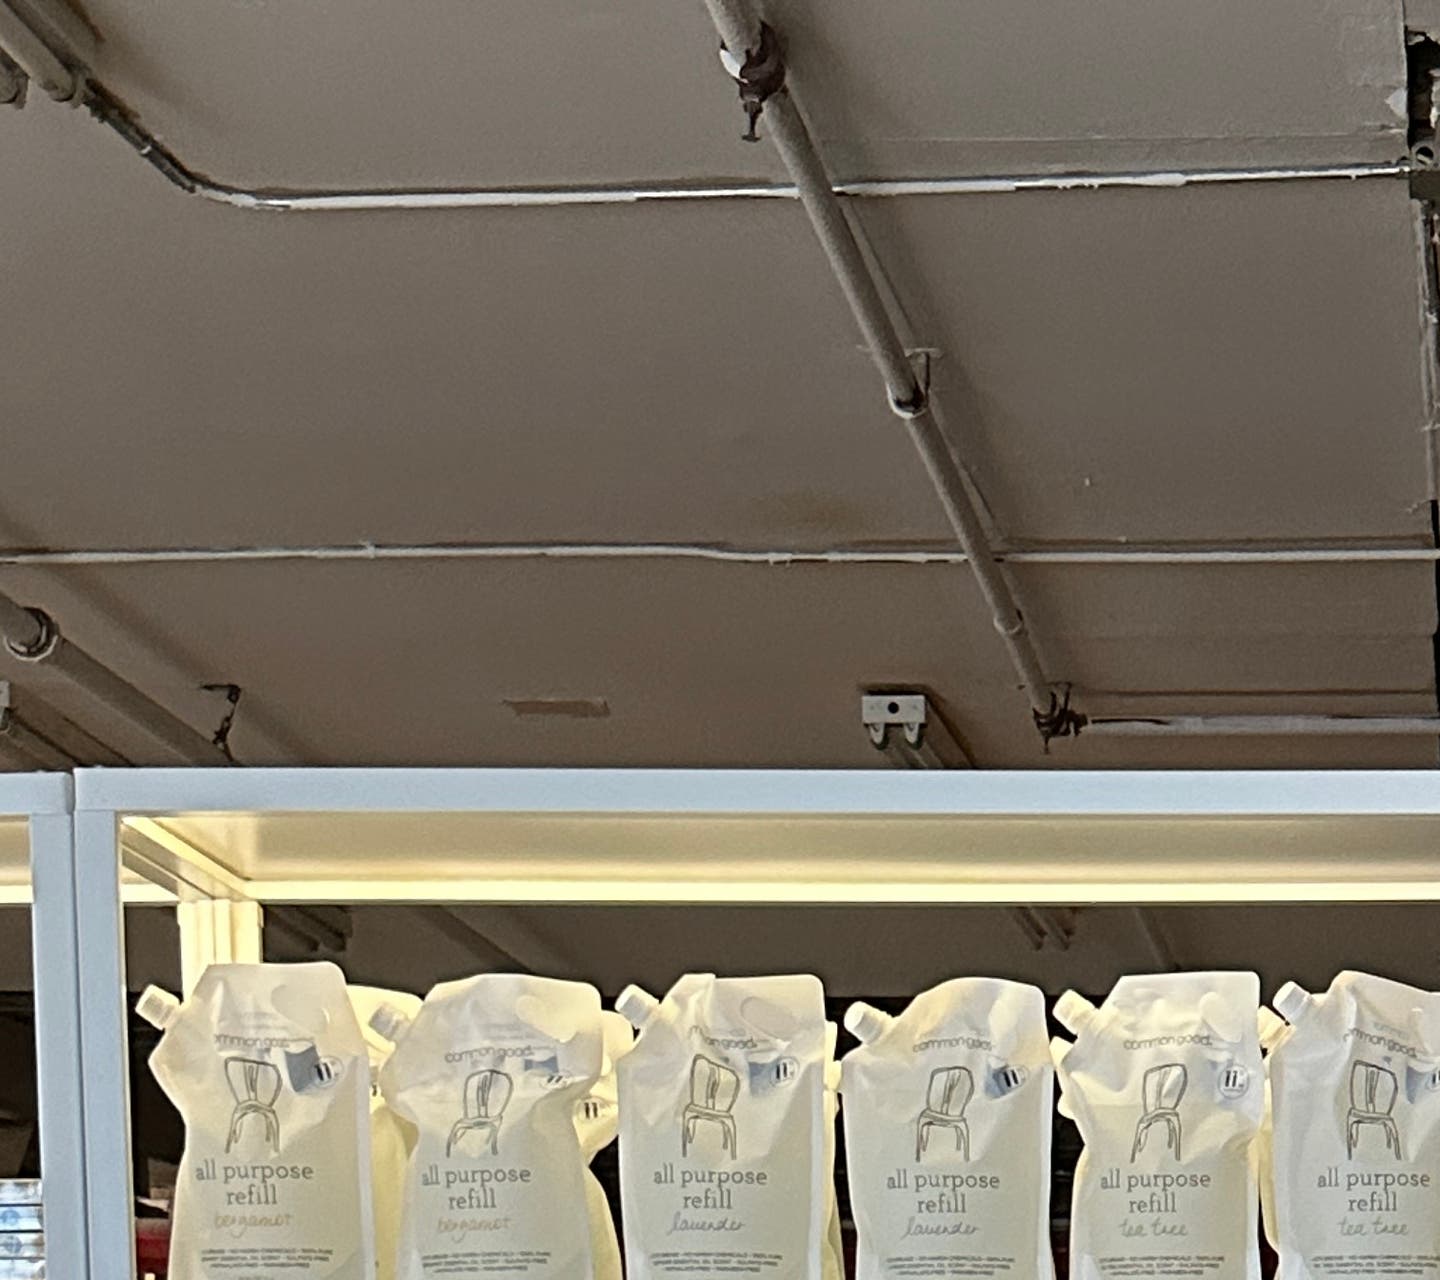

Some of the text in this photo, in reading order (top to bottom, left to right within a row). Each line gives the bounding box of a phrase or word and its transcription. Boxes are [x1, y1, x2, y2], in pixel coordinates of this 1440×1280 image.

[195, 1159, 314, 1184] all purpose
[421, 1165, 532, 1188] all purpose
[653, 1163, 768, 1188] all purpose
[886, 1169, 1001, 1192] all purpose
[1100, 1168, 1211, 1193] all purpose
[1317, 1167, 1431, 1192] all purpose
[226, 1184, 278, 1206] refill
[448, 1188, 497, 1211] refill
[683, 1188, 733, 1210] refill
[917, 1193, 966, 1214] refill
[1128, 1192, 1177, 1214] refill
[1347, 1191, 1398, 1213] refill
[668, 1211, 746, 1236] lavender
[901, 1216, 979, 1240] lavender
[1118, 1217, 1190, 1238] tea tree
[1337, 1217, 1409, 1237] tea tree
